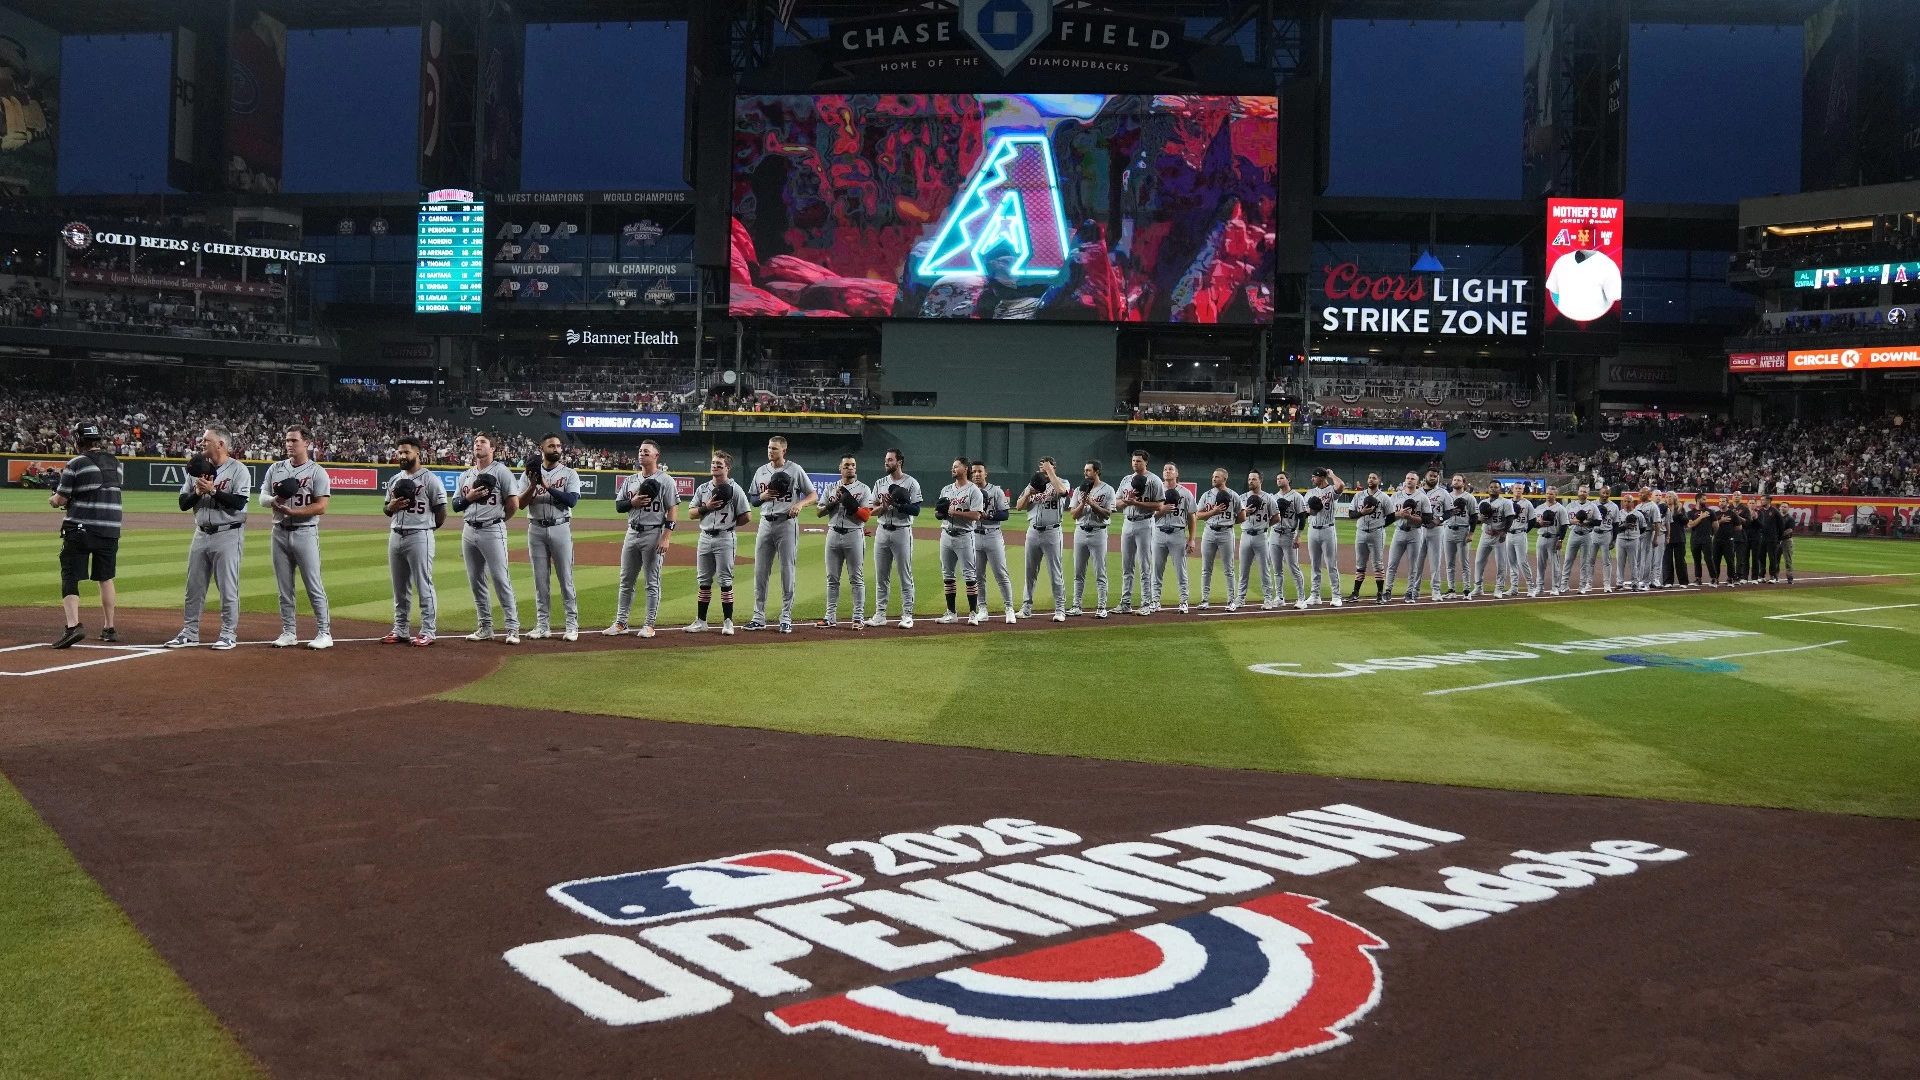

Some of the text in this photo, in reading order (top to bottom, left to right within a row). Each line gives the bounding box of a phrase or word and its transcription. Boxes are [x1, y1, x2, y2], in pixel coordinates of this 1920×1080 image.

[842, 22, 1170, 50] CHASE FIELD
[881, 57, 1130, 72] HOME OF THE DIAMONDBACKS
[494, 194, 584, 202] NL WEST CHAMPIONS
[604, 193, 684, 202] WORLD CHAMPIONS
[1553, 206, 1618, 218] MOTHER'S DAY
[96, 232, 326, 263] COLD BEERS & CHEESEBURGERS
[512, 266, 559, 274] WILD CARD
[608, 265, 676, 274] NL CHAMPIONS
[111, 272, 227, 290] Your Neighborhood Burger Joint
[1323, 262, 1528, 304] Coors LIGHT
[1322, 307, 1528, 335] STRIKE ZONE
[582, 331, 679, 344] Banner Health
[1794, 354, 1838, 366] CIRCLE
[1870, 352, 1920, 362] DOWNL
[586, 417, 618, 428] OPENING
[1344, 434, 1378, 445] OPENING
[1379, 434, 1395, 445] DAY
[1395, 436, 1414, 446] 2026
[1415, 438, 1440, 447] Adobe
[330, 477, 368, 485] dweiser
[1044, 500, 1058, 510] 38
[720, 513, 728, 523] 7
[1256, 514, 1268, 522] 34
[1248, 630, 1765, 678] CASINO ARIZONA
[826, 818, 1082, 876] 2026
[1364, 840, 1688, 930] Adobe
[503, 804, 1465, 1026] OPENING DAY
